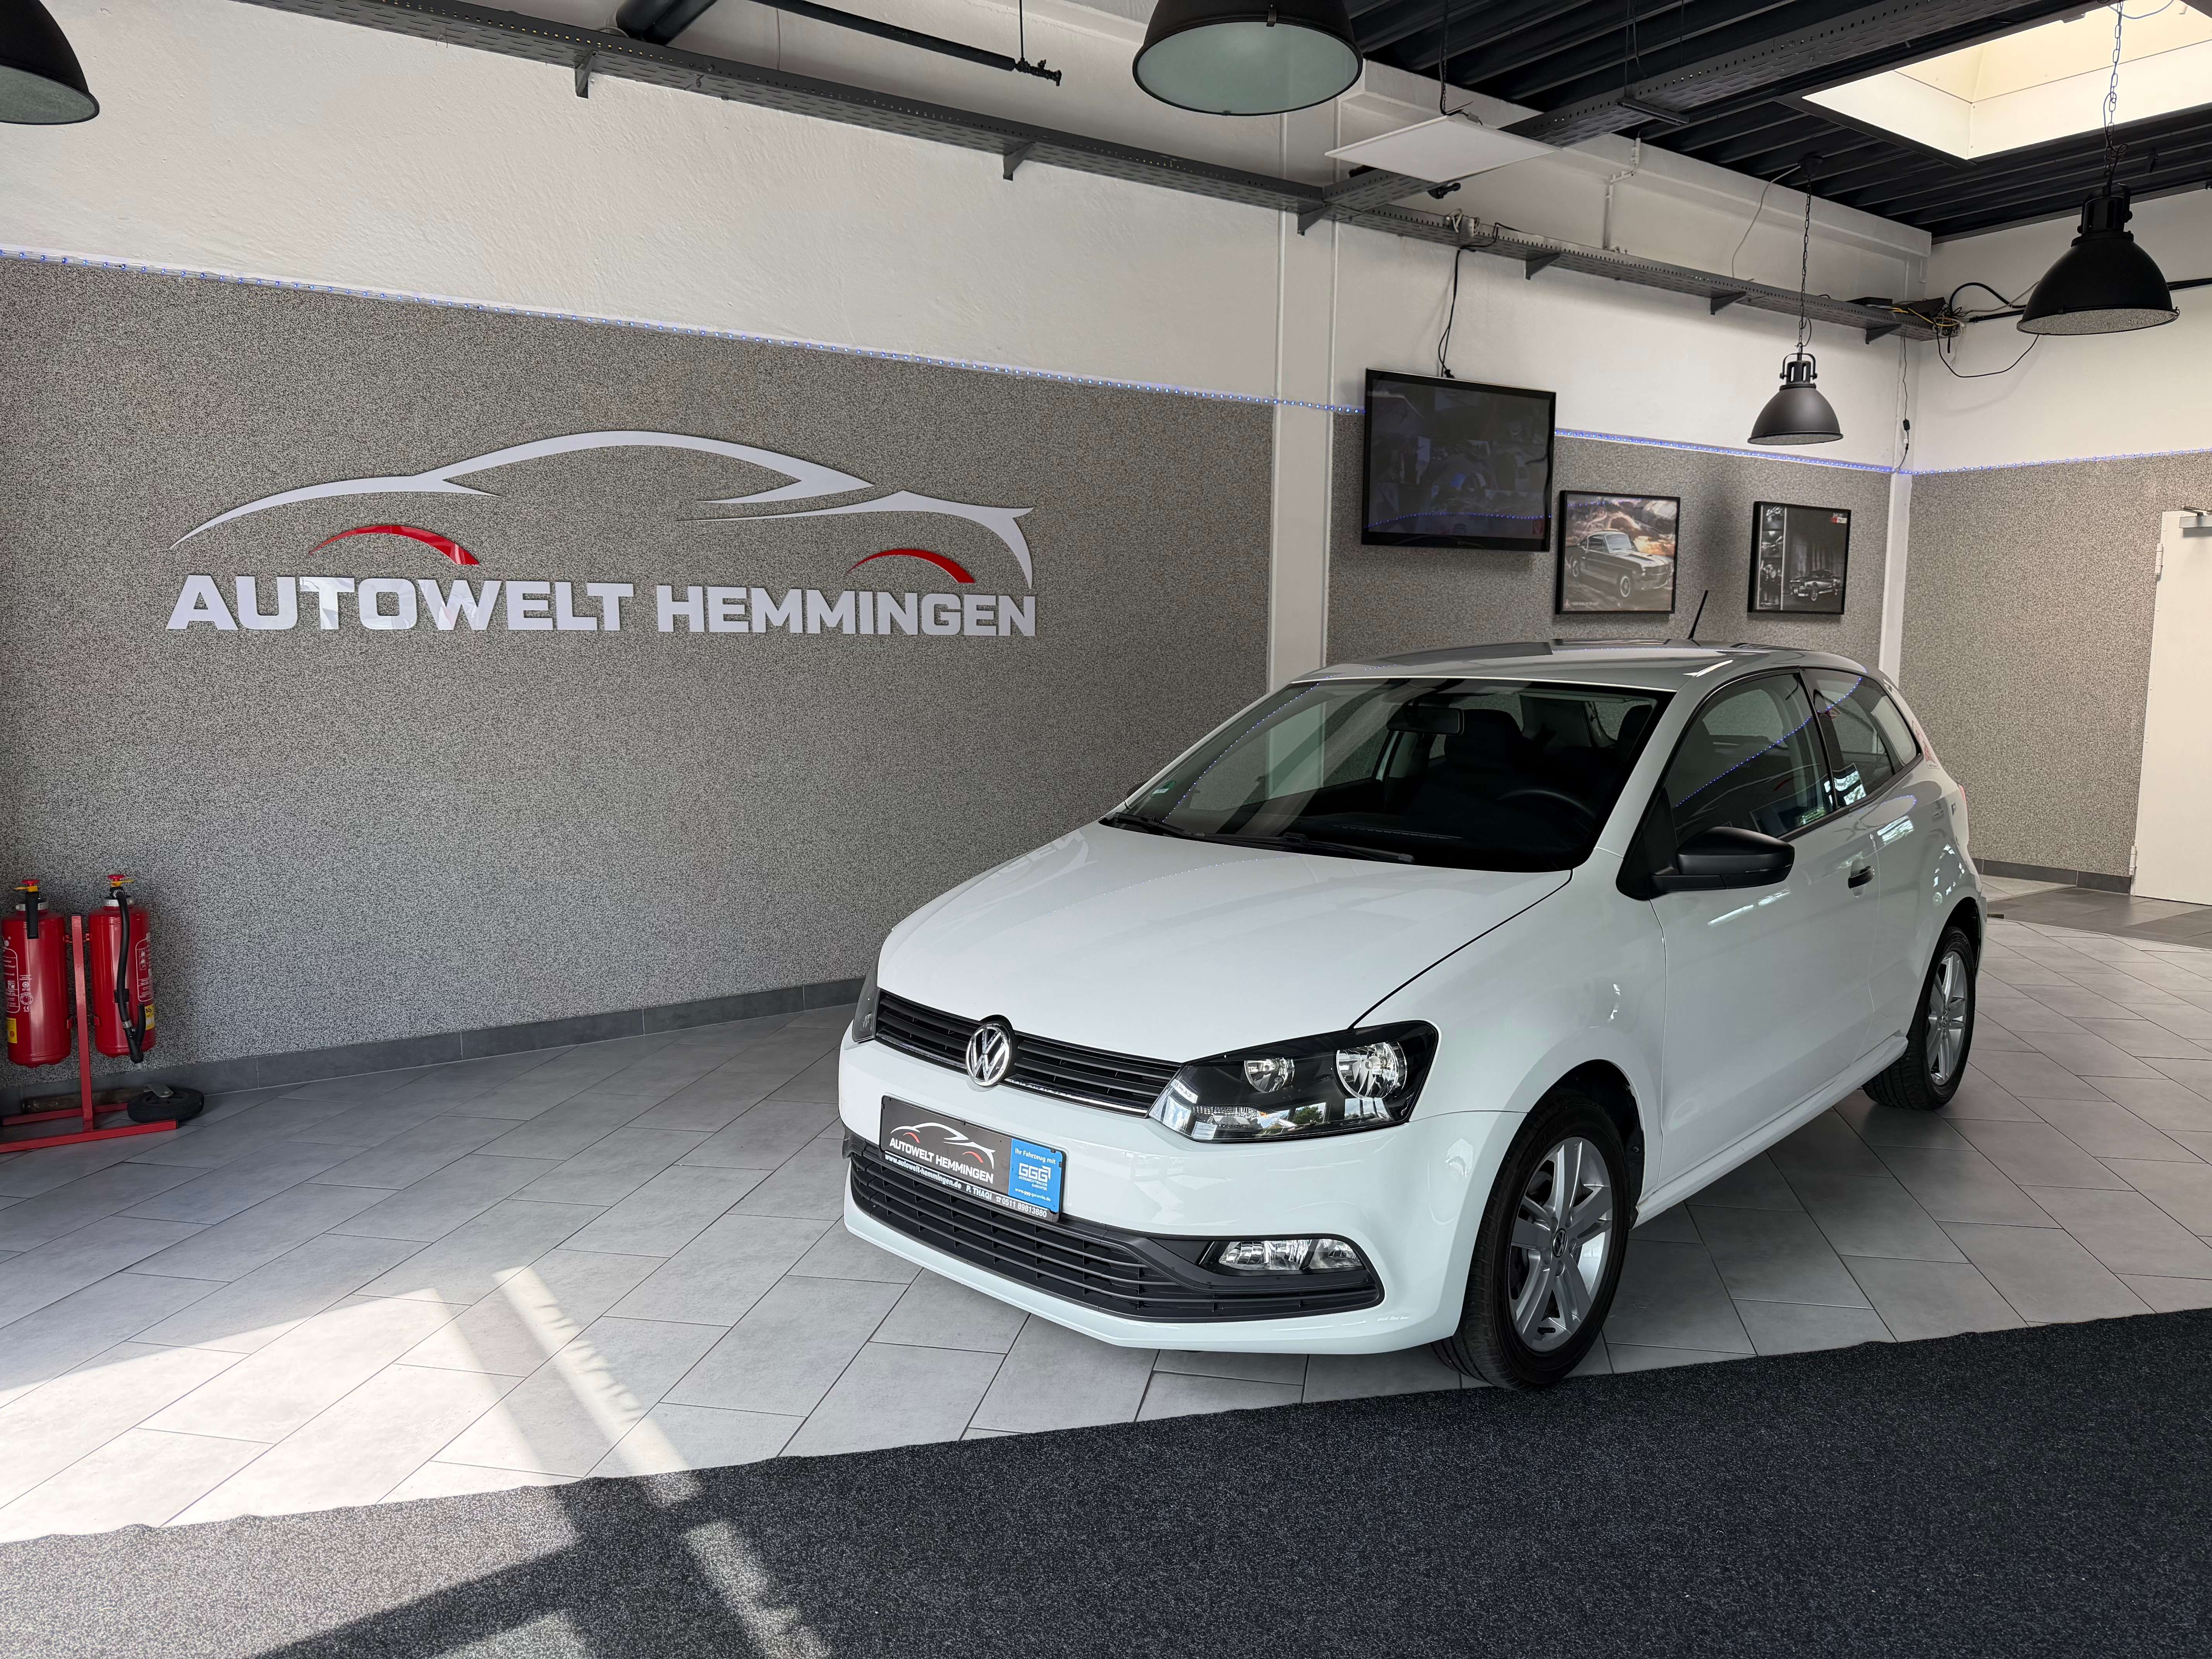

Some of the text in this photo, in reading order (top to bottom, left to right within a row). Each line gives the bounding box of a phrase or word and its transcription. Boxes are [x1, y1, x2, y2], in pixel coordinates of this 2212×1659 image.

[167, 575, 1036, 637] AUTOWELT HEMMINGEN
[890, 1137, 994, 1183] AUTOWELT HEMMINGEN
[1018, 1162, 1048, 1183] GGG
[1023, 1150, 1046, 1163] Fahrzeug
[885, 1154, 1047, 1218] www.autowelt-hemmingen.de P. THAQI 0511 89813880
